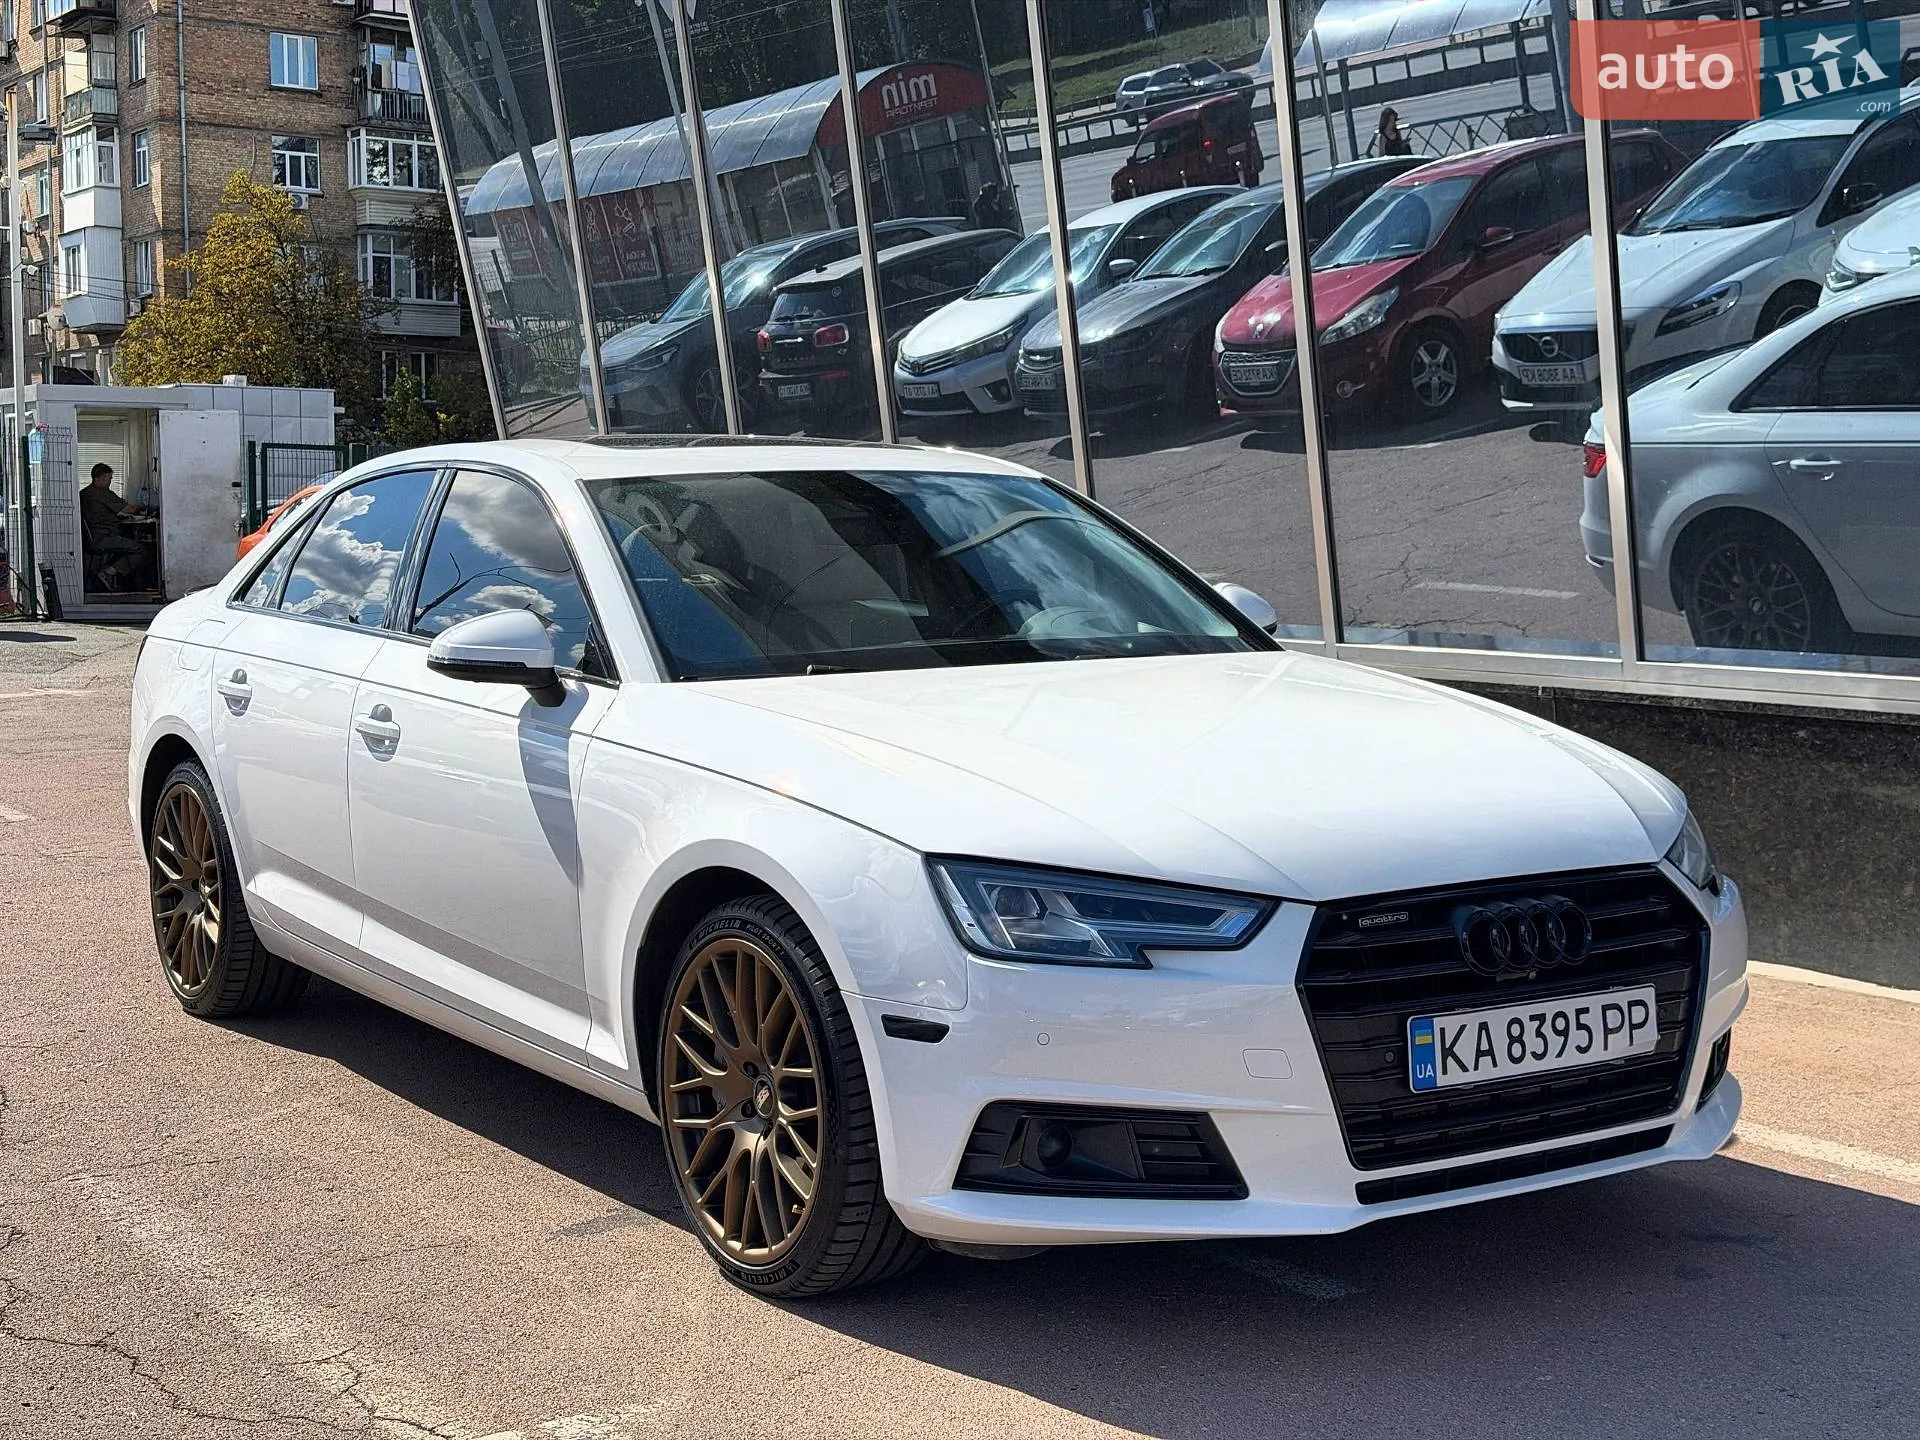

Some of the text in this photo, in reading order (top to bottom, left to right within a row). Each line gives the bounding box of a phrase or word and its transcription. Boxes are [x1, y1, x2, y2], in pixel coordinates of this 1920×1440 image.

[1361, 913, 1408, 927] quattro
[698, 919, 742, 939] MICHELIN
[762, 933, 781, 951] SPORT
[1439, 998, 1650, 1075] KA 8395 PP
[1416, 1063, 1435, 1080] UA
[740, 1268, 787, 1283] MICHELIN
